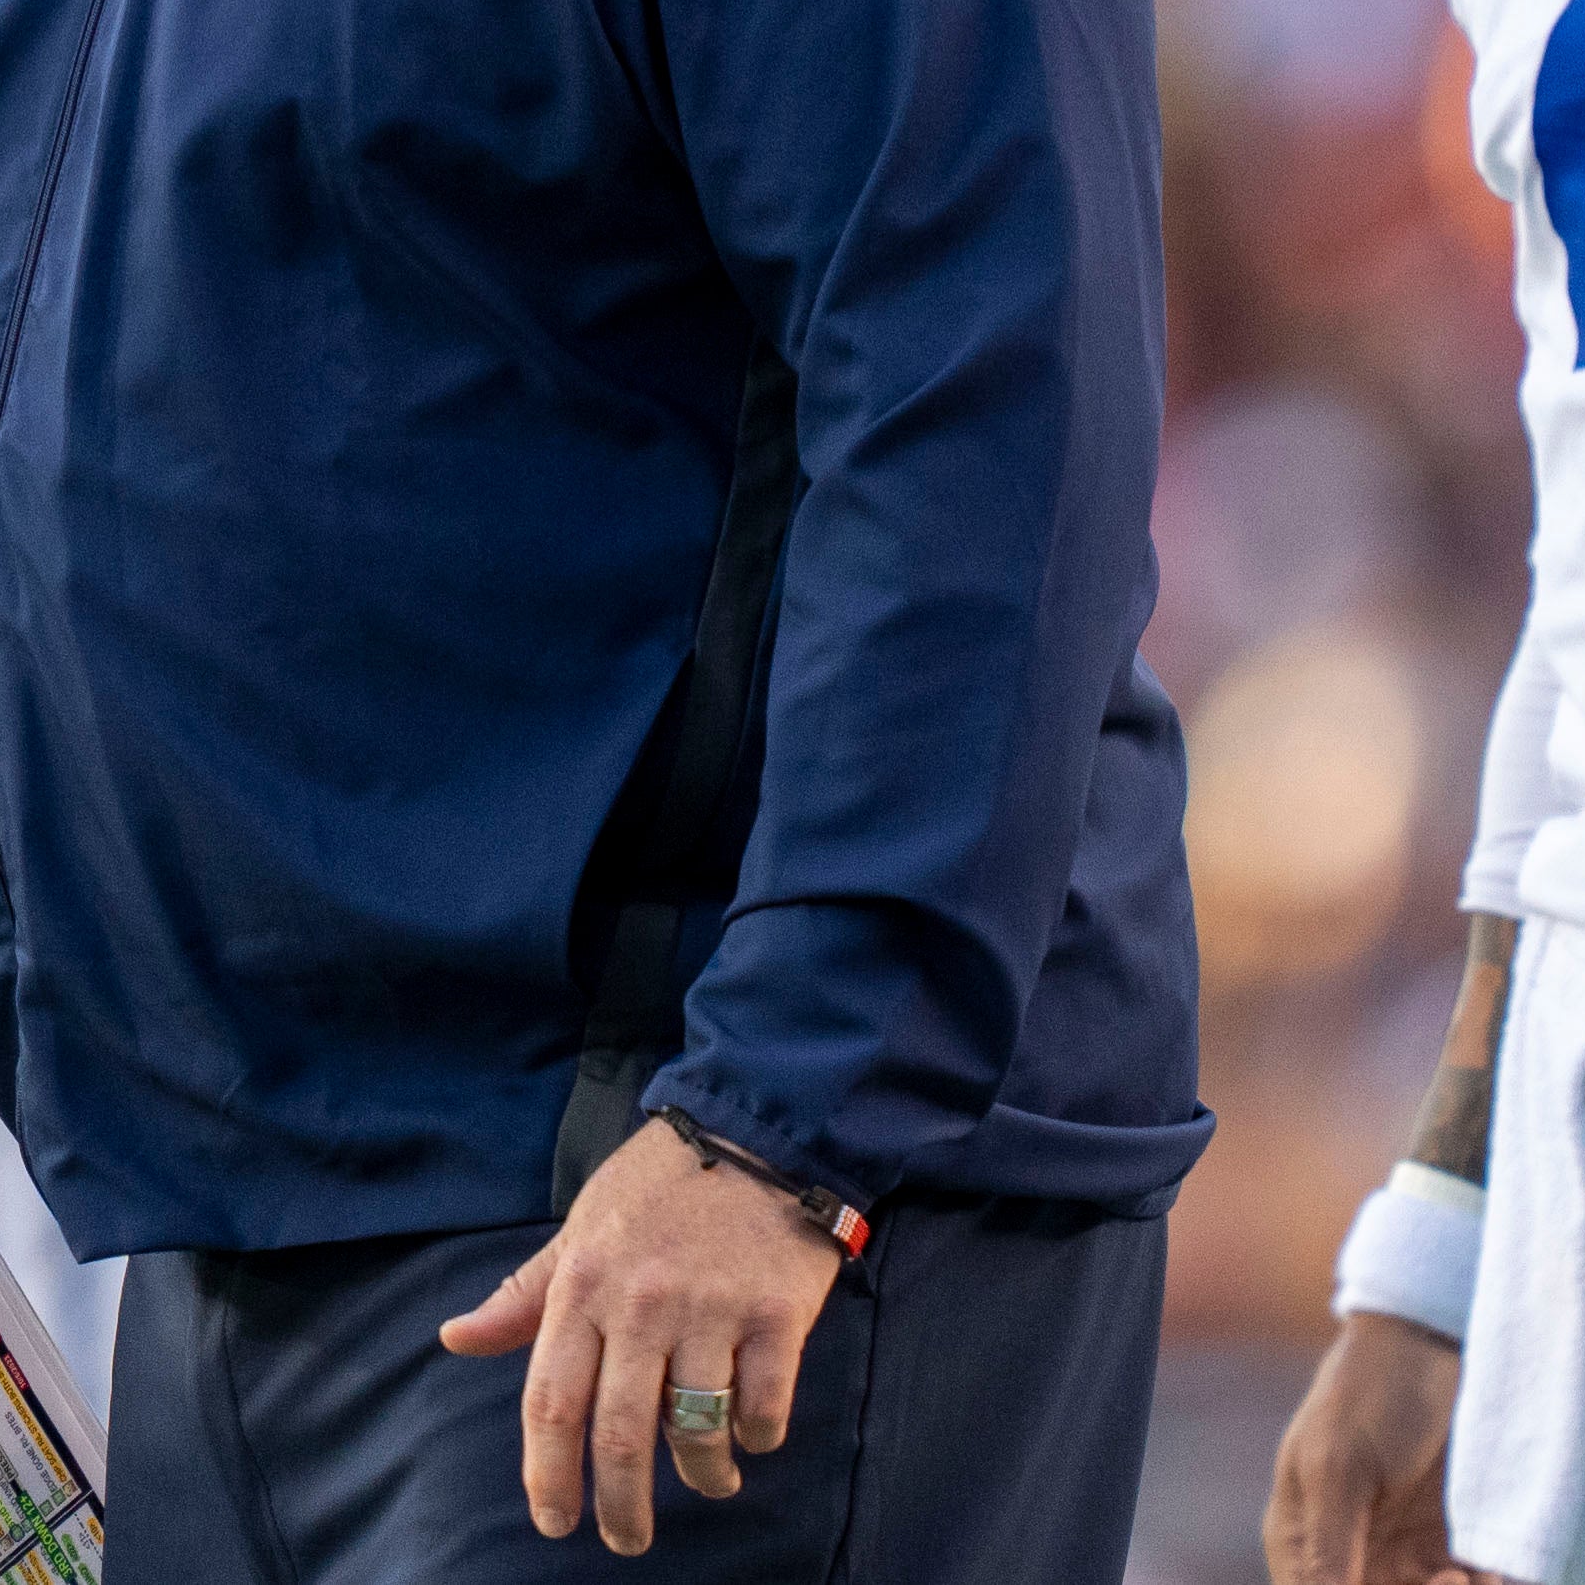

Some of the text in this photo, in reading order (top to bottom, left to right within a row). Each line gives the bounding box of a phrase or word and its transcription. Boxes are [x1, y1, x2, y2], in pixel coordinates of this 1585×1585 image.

[4, 1410, 23, 1435] BITES
[25, 1446, 45, 1471] GONE
[39, 1469, 58, 1492] EDGE
[17, 1492, 37, 1515] 12+
[30, 1515, 58, 1552] DOWN
[51, 1549, 73, 1577] 3RD
